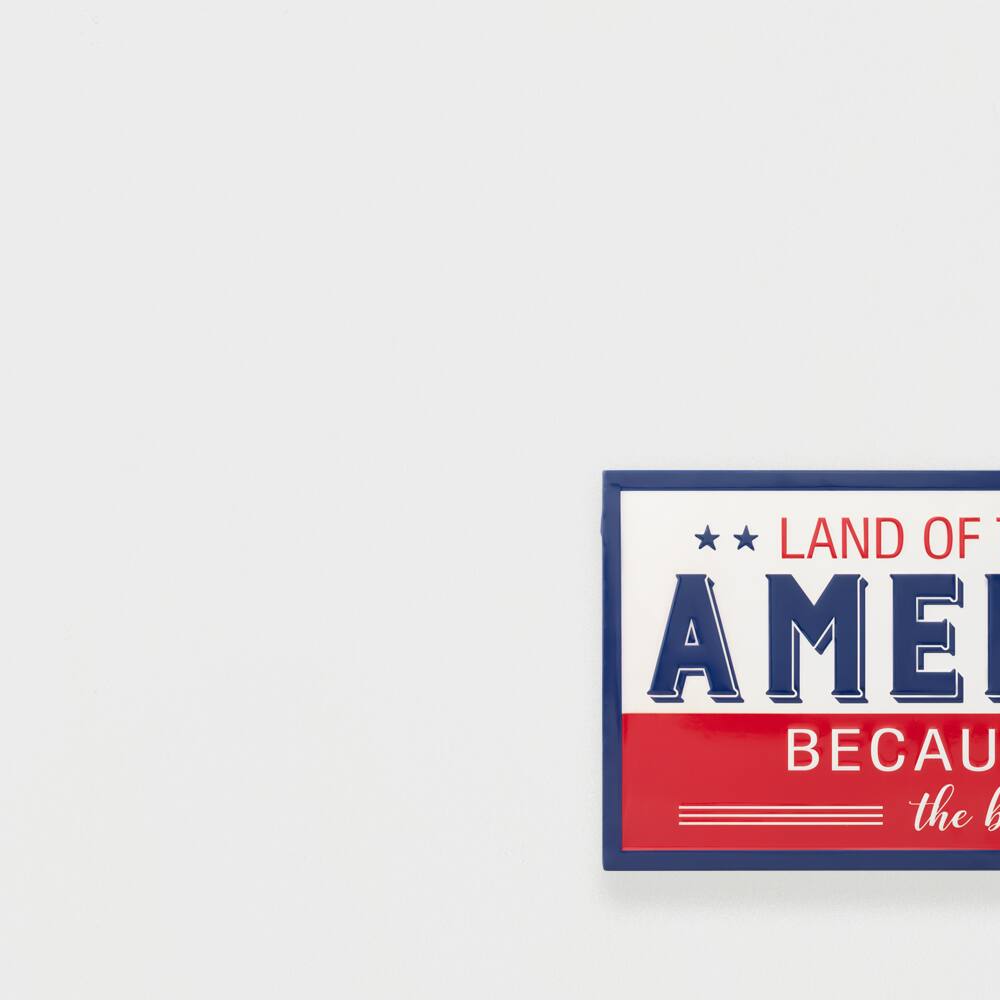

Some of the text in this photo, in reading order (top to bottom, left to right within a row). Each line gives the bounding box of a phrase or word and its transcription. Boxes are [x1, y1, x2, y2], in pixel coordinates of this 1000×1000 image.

[781, 516, 905, 560] LAND
[923, 516, 981, 560] OF
[908, 783, 974, 832] the
